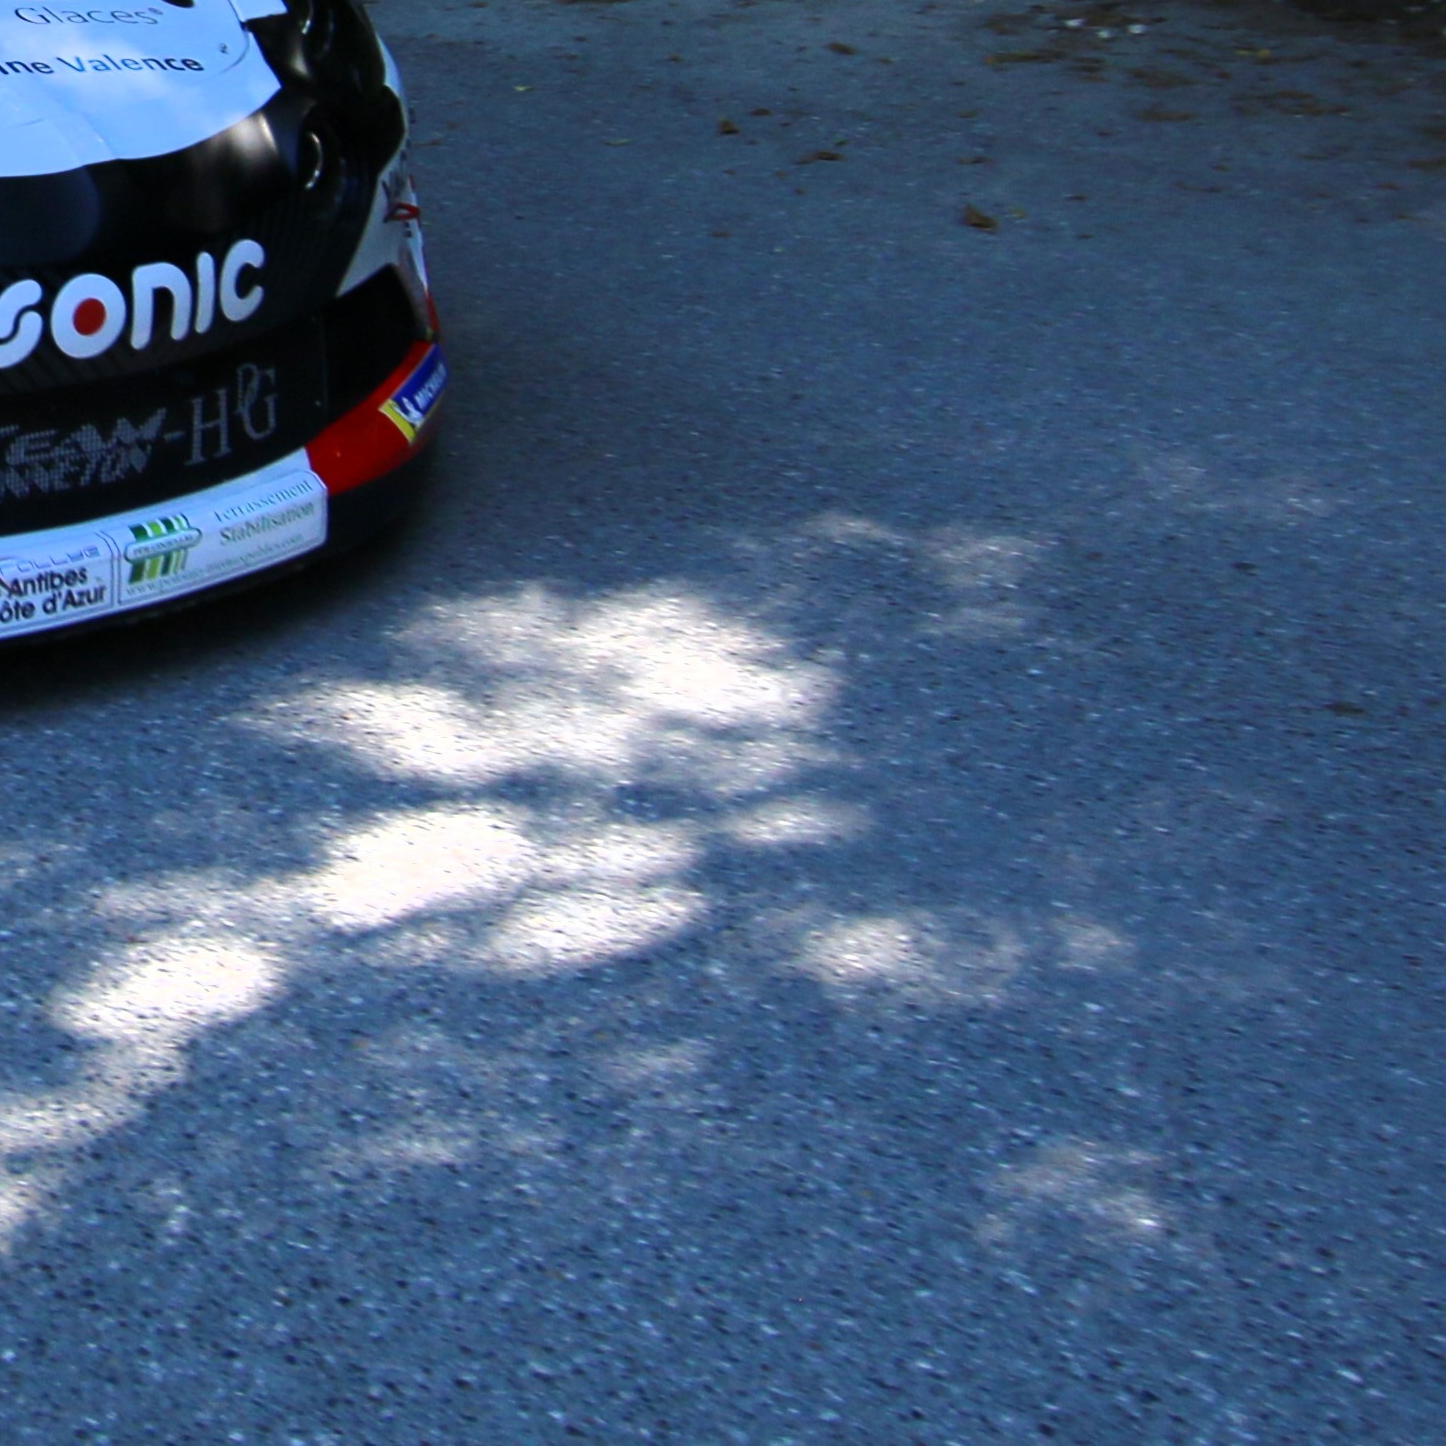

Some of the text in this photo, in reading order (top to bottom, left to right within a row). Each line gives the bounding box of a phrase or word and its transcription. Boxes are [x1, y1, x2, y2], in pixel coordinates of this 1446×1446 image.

[13, 6, 158, 27] Glaces
[56, 54, 205, 73] Valence
[213, 479, 314, 524] Terrassement
[219, 501, 316, 546] Stabilisation
[7, 567, 89, 599] Antibes
[41, 585, 107, 615] d'Azur
